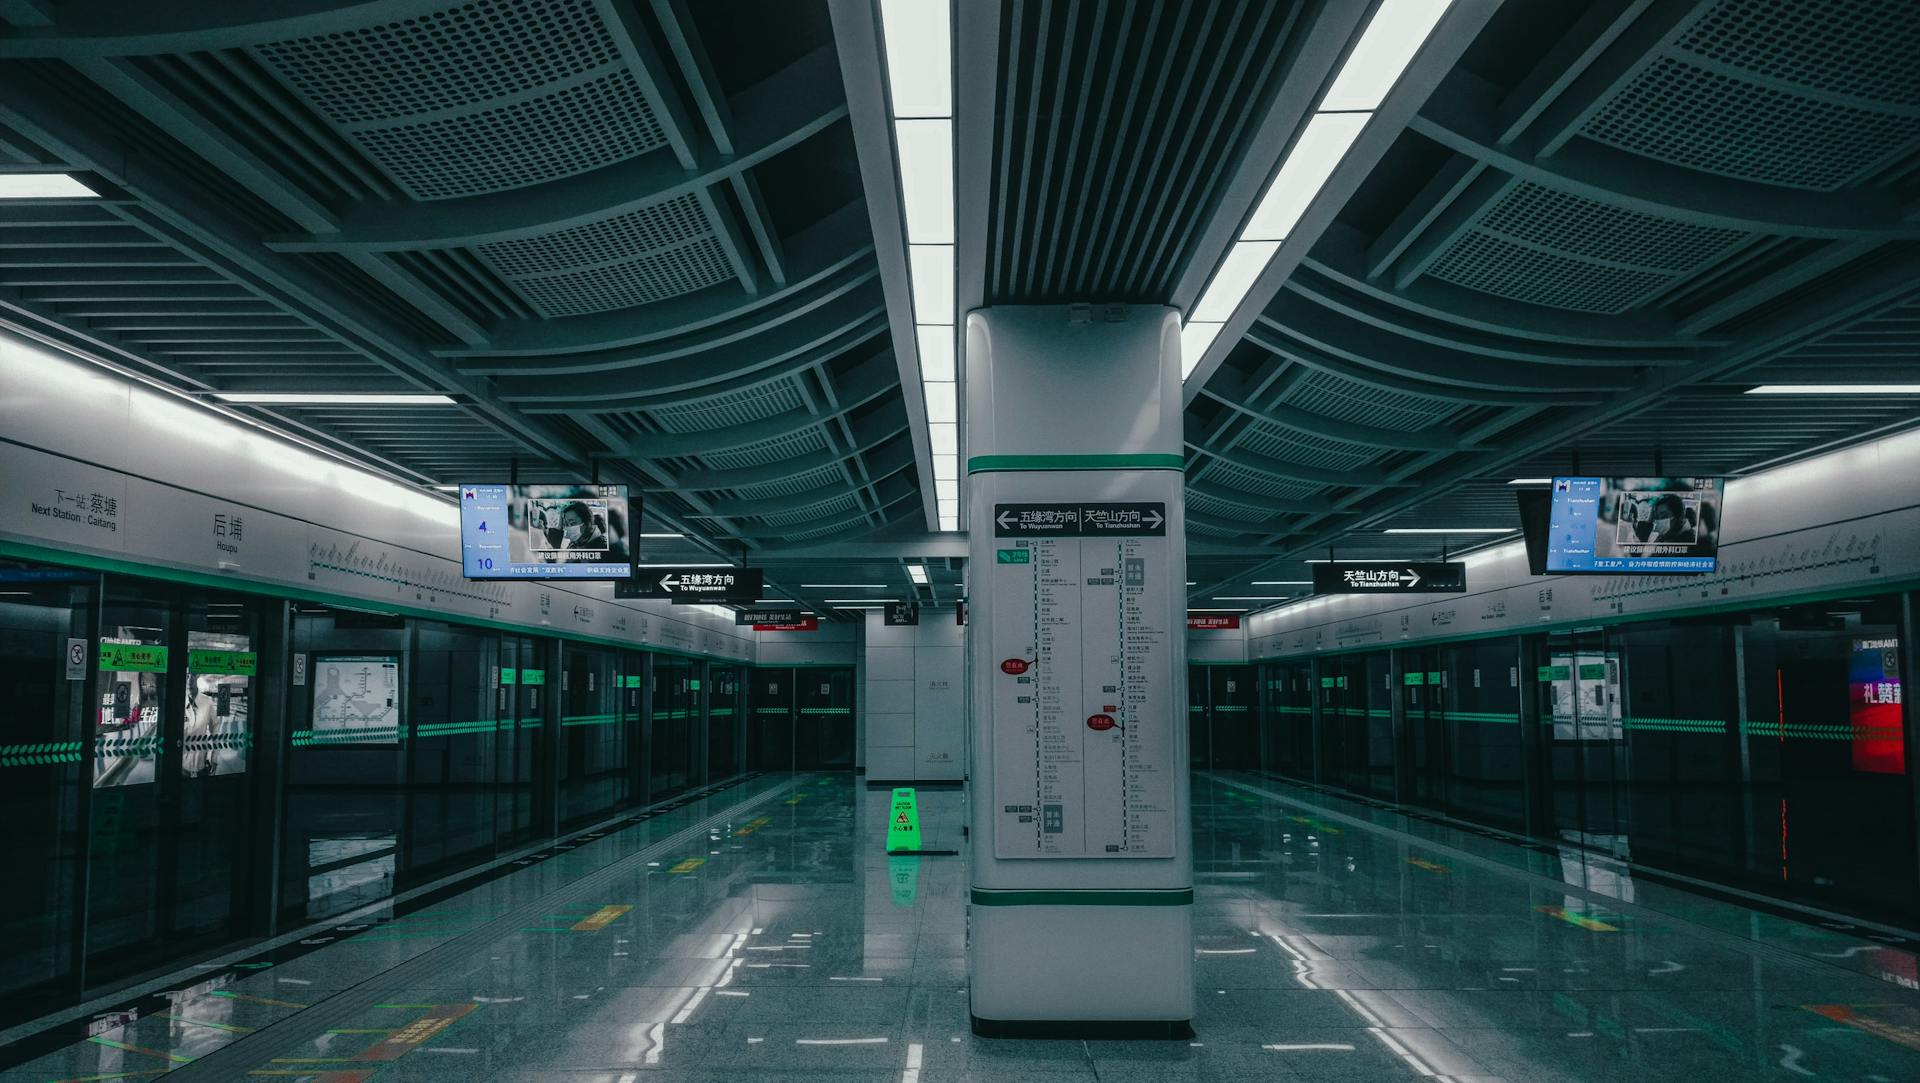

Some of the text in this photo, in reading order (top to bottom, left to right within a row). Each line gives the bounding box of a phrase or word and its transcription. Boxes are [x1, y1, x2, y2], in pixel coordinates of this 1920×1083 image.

[31, 502, 52, 516] Next
[52, 506, 82, 523] Station
[87, 516, 117, 532] Caitang
[1019, 511, 1077, 523] 五缘湾方向
[1085, 510, 1140, 522] 天竺山方向
[212, 514, 244, 542] 后埔
[479, 521, 487, 532] 4
[216, 541, 239, 554] Houpu
[478, 558, 492, 570] 10
[680, 575, 734, 585] 五缘湾方向
[1344, 571, 1399, 581] 天竺山方向
